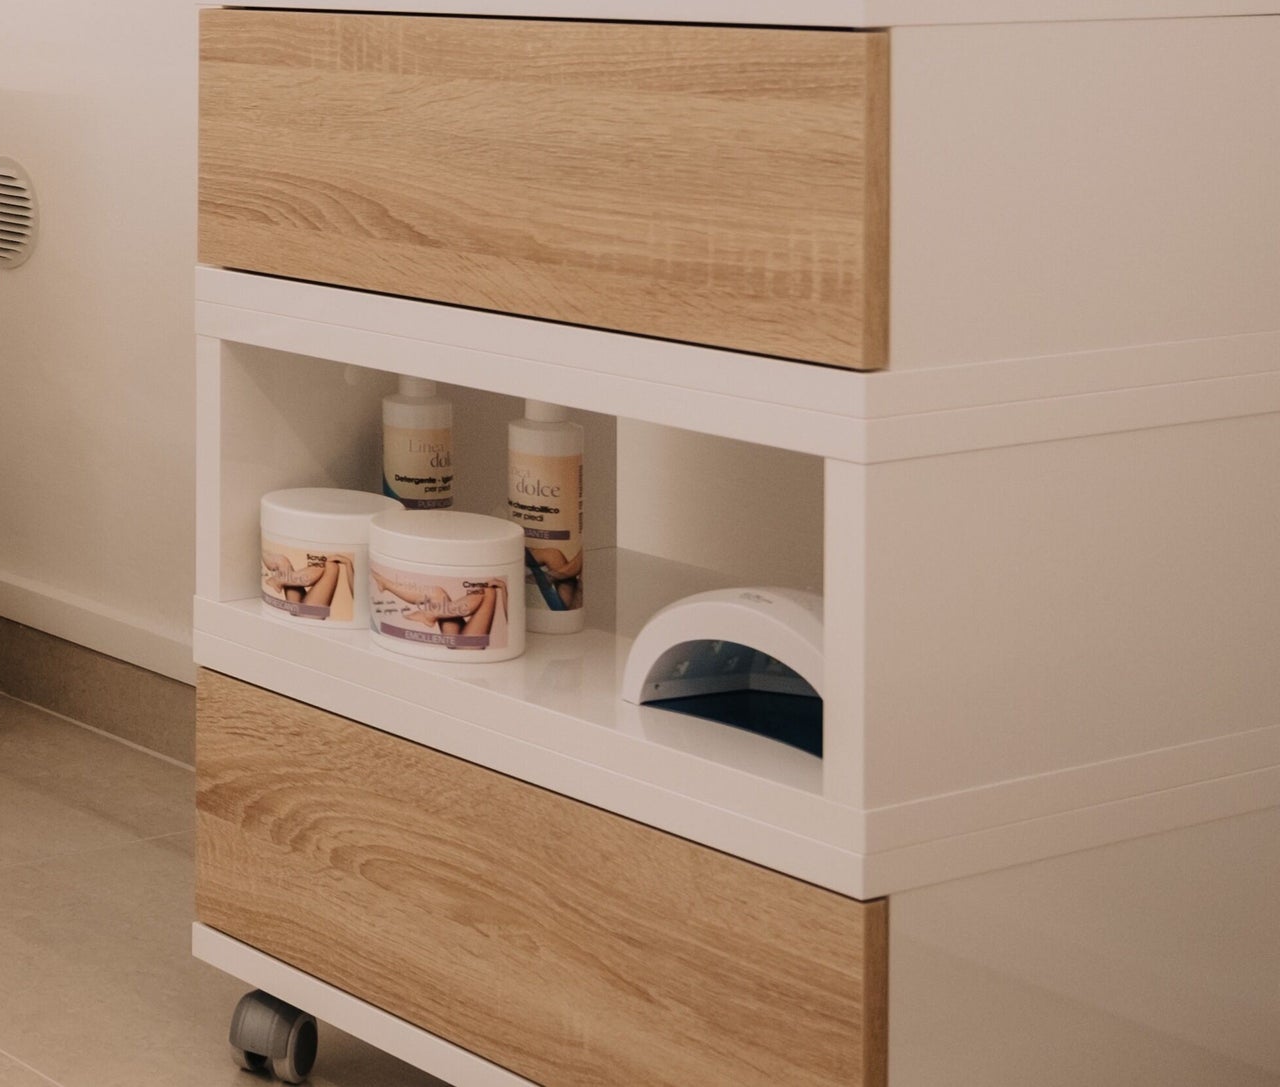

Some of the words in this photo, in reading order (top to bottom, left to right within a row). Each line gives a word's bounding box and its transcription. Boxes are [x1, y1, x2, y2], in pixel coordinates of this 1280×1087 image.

[408, 439, 445, 453] Linea
[430, 451, 452, 468] dol
[394, 473, 437, 485] Detergente
[515, 478, 561, 498] dolce
[523, 512, 544, 523] piedi
[306, 553, 328, 562] Scrub
[462, 580, 489, 590] Crema
[404, 630, 456, 646] EMOLLIENTE
